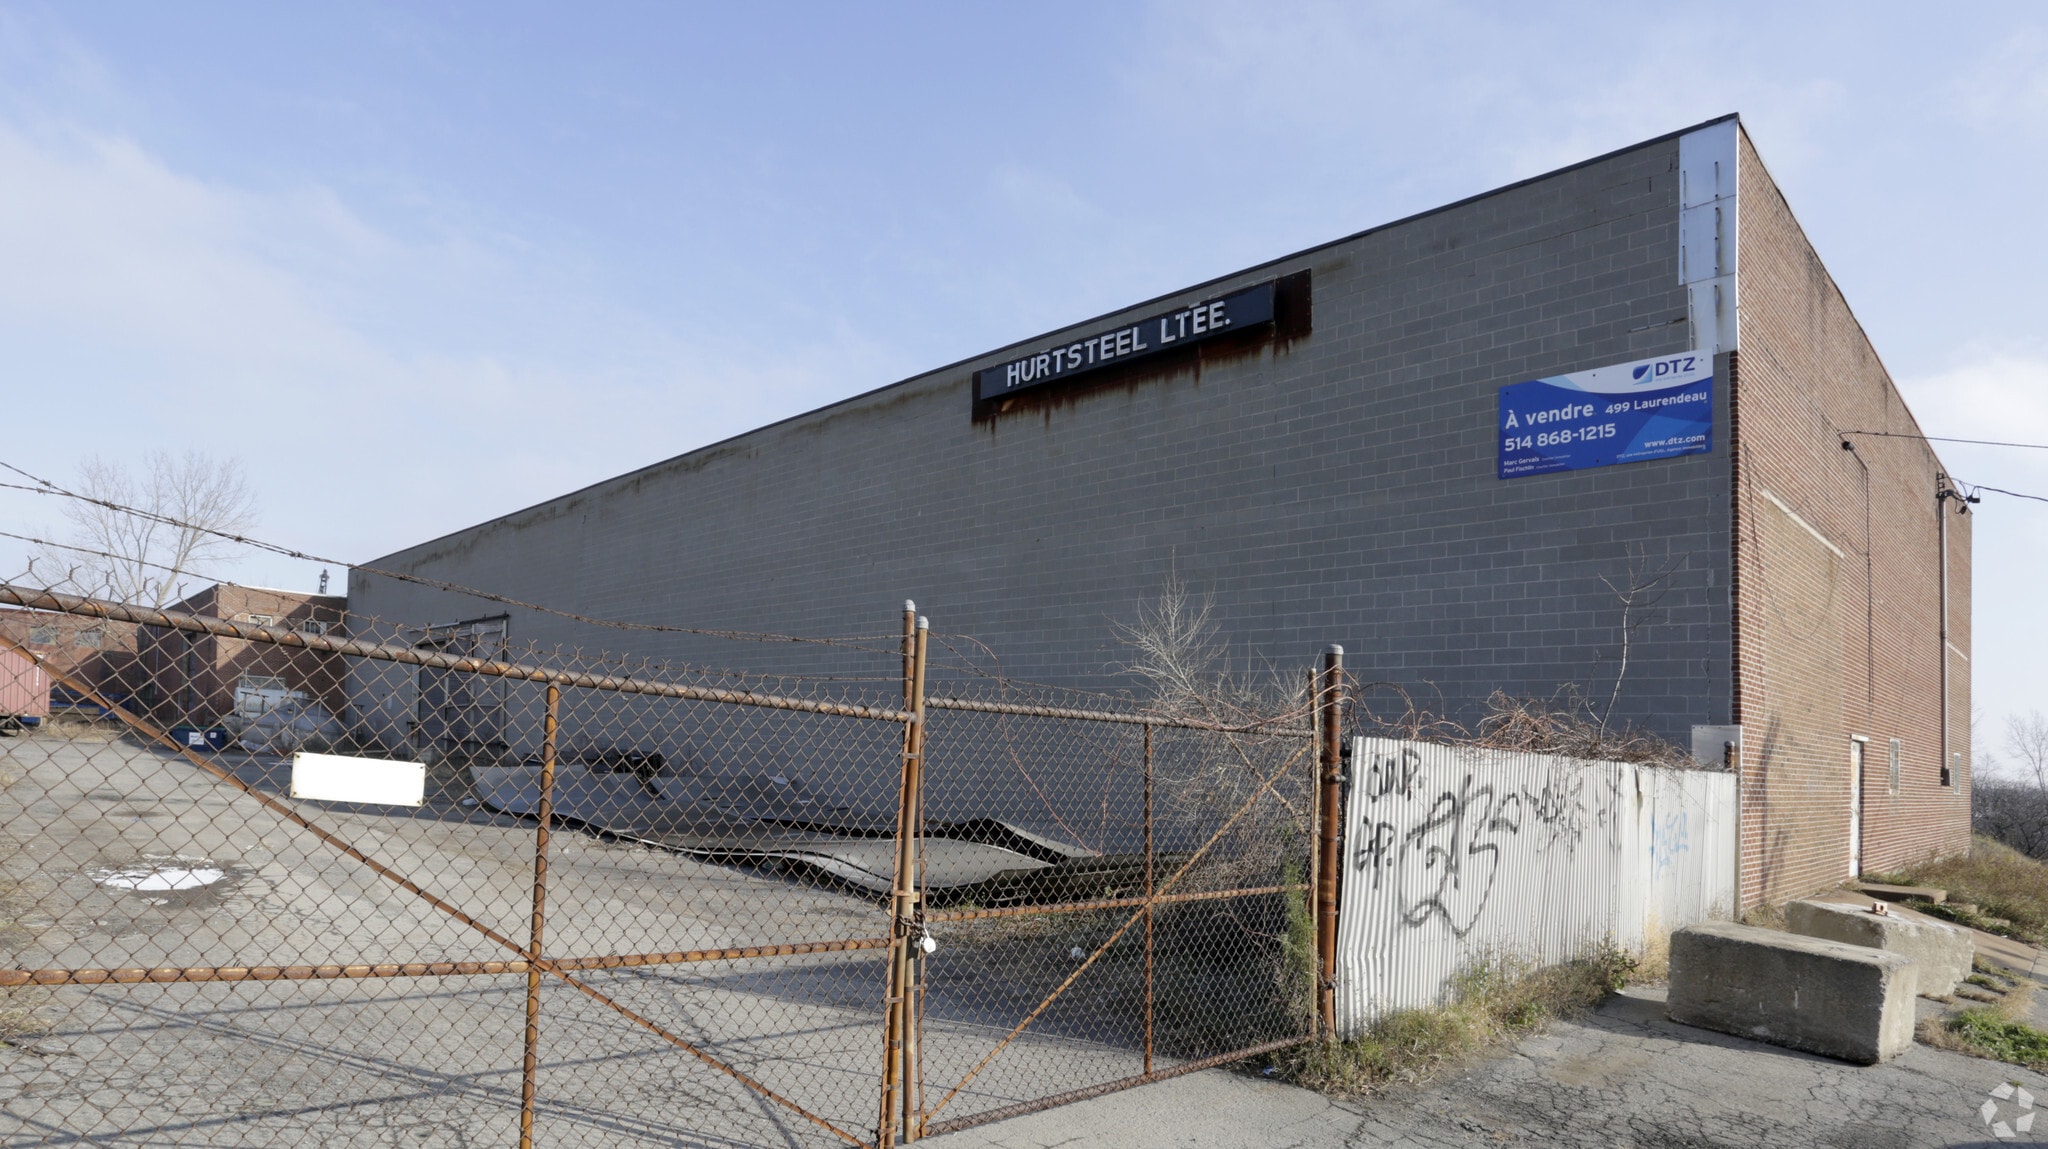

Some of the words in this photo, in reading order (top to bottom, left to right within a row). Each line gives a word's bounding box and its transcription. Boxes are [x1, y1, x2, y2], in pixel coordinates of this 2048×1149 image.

[1006, 326, 1148, 388] HURTSTEEL
[1655, 356, 1696, 377] DTZ
[1605, 401, 1631, 415] 499
[1634, 391, 1707, 411] Laurendeau
[1505, 409, 1519, 430] À
[1525, 403, 1594, 426] vendre
[1504, 434, 1533, 452] 514
[1536, 423, 1616, 447] 868-1215
[1644, 434, 1706, 448] www.dtz.com
[1503, 459, 1518, 467] Marc
